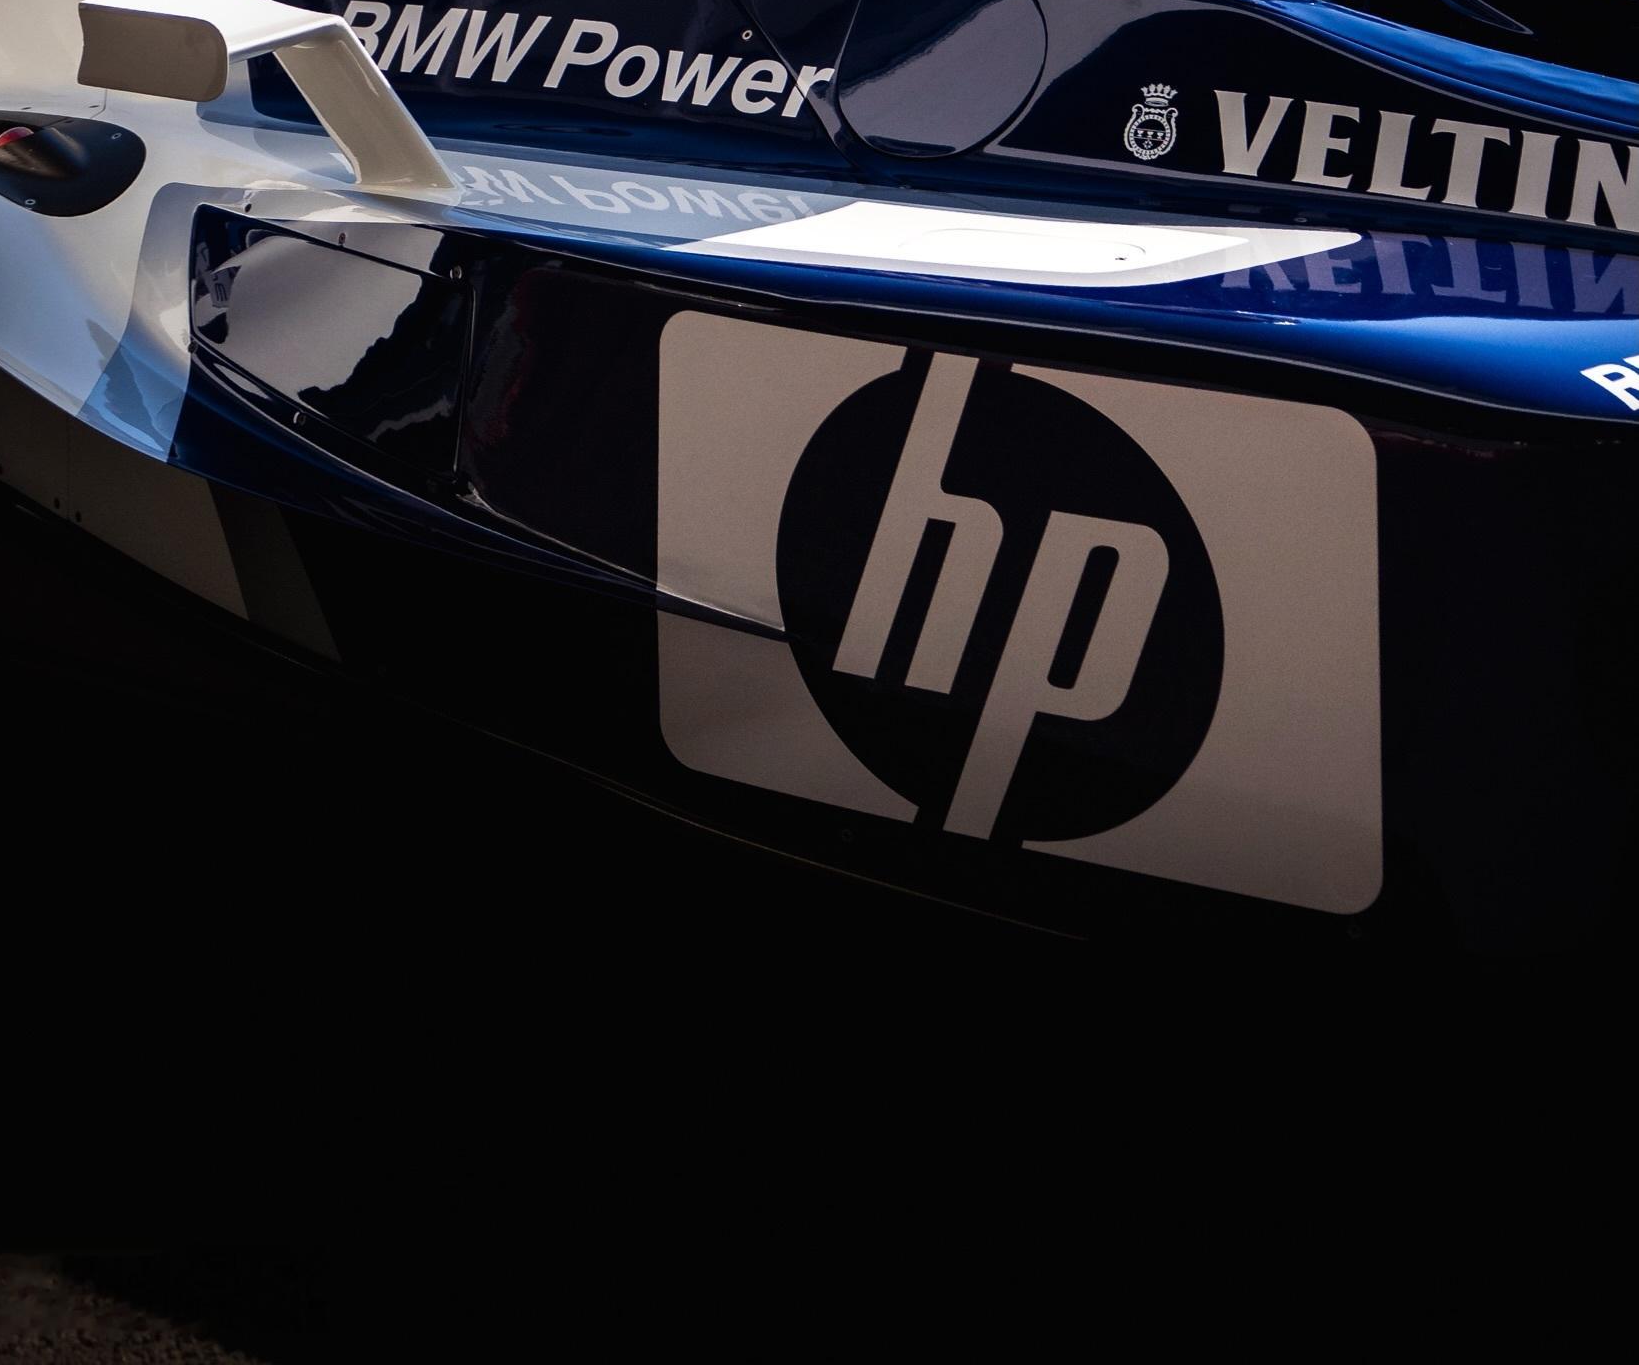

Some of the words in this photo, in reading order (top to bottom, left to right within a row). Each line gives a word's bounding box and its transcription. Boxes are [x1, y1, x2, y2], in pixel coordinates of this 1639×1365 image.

[339, 0, 553, 84] BMW
[543, 18, 836, 119] Power
[1214, 89, 1639, 233] VELTIN
[832, 351, 1170, 841] hp
